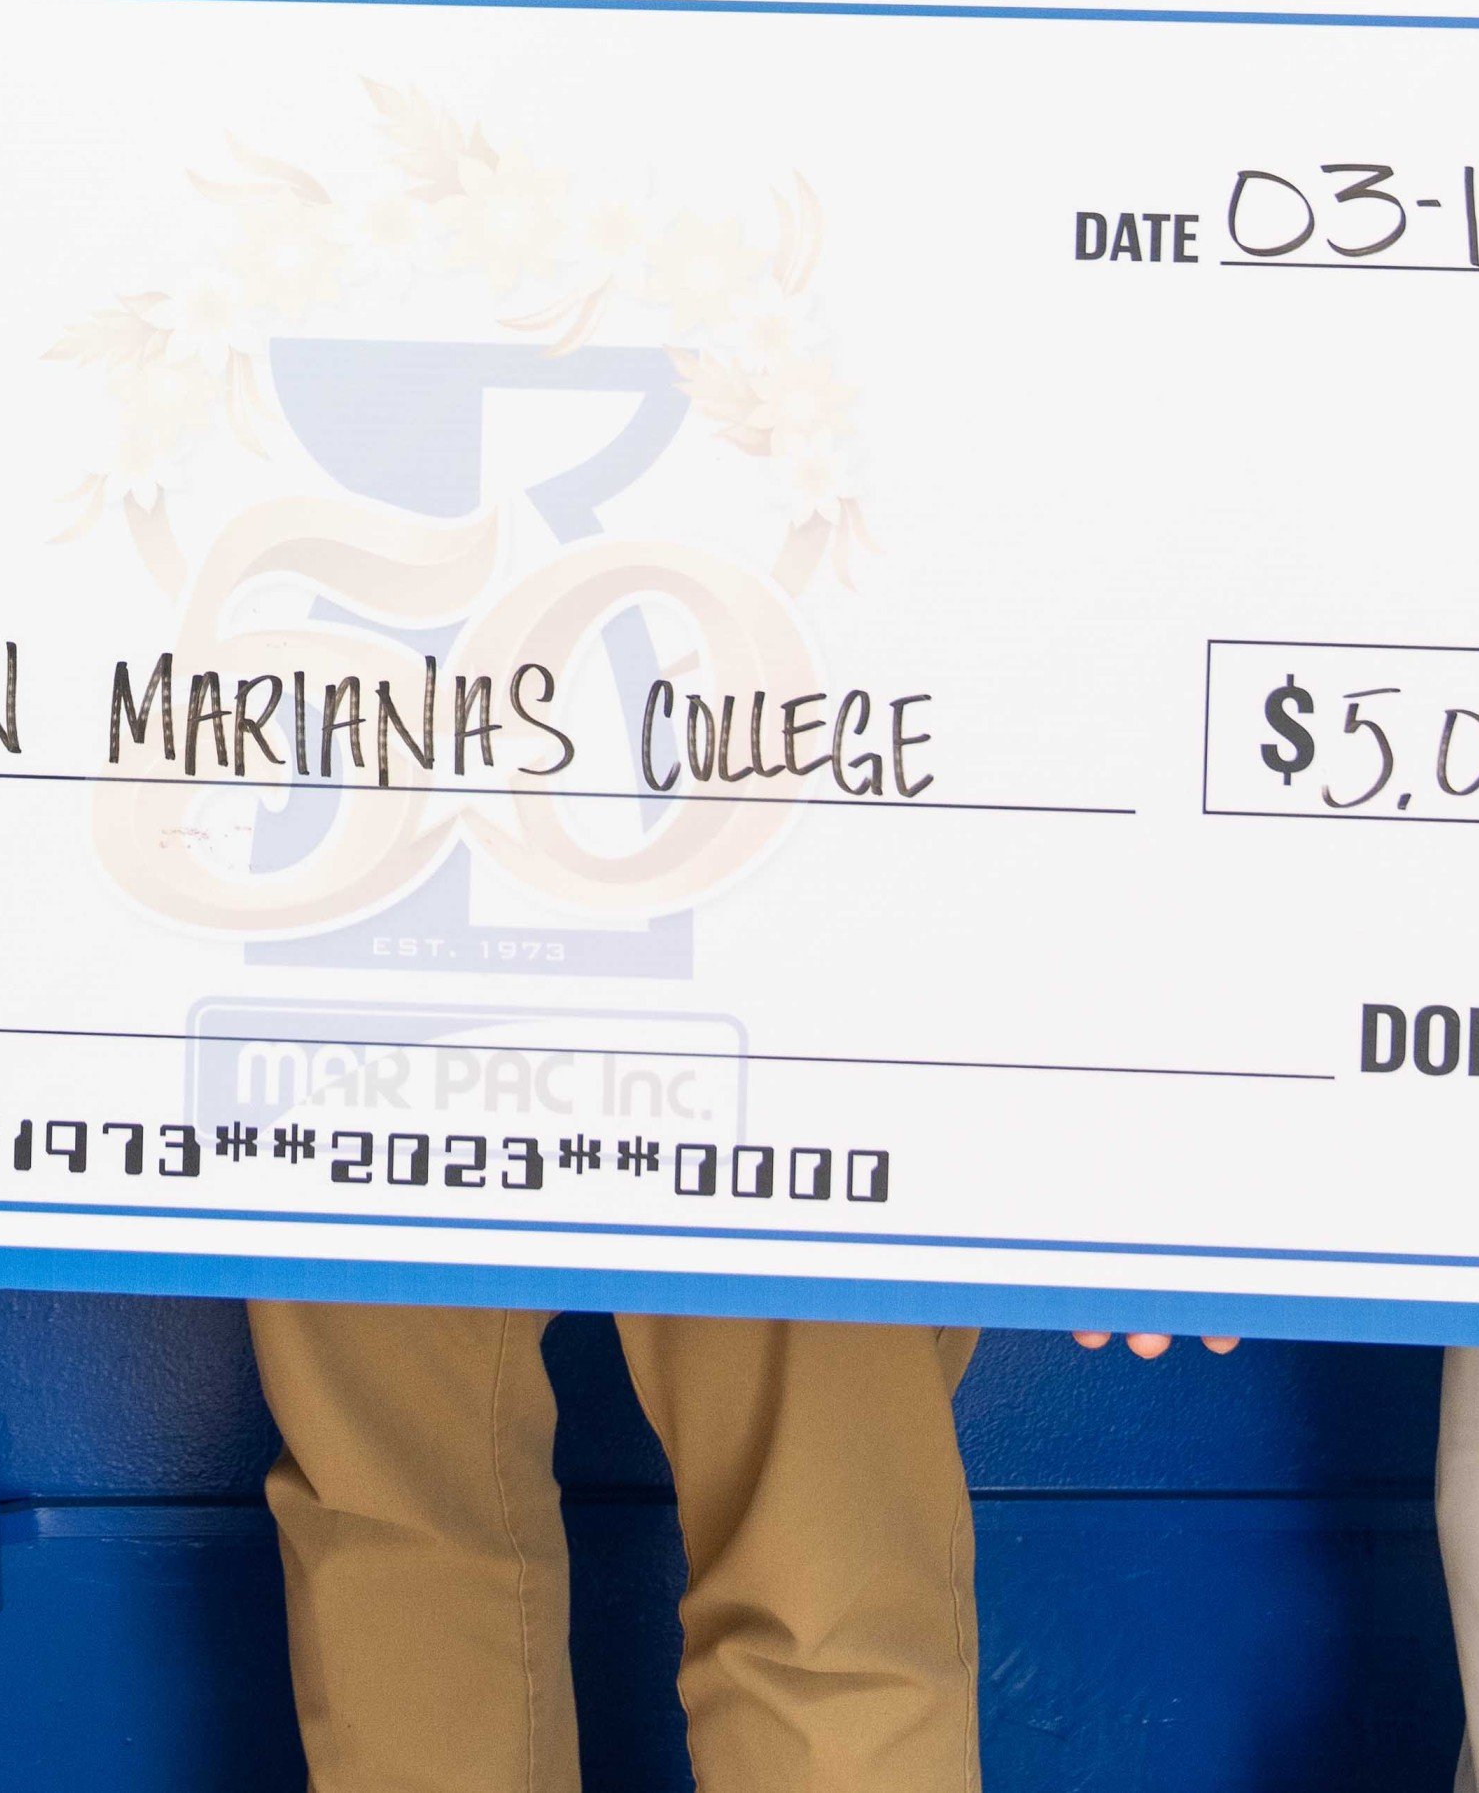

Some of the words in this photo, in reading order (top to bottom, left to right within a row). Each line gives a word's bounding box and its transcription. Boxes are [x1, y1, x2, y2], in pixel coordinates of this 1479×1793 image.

[1074, 211, 1200, 264] DATE
[108, 652, 576, 788] MARIANAS
[641, 678, 934, 799] COLLEGE
[372, 936, 458, 959] EST.
[480, 939, 566, 962] 1973
[434, 1047, 580, 1118] PAC
[603, 1055, 715, 1124] Inc.
